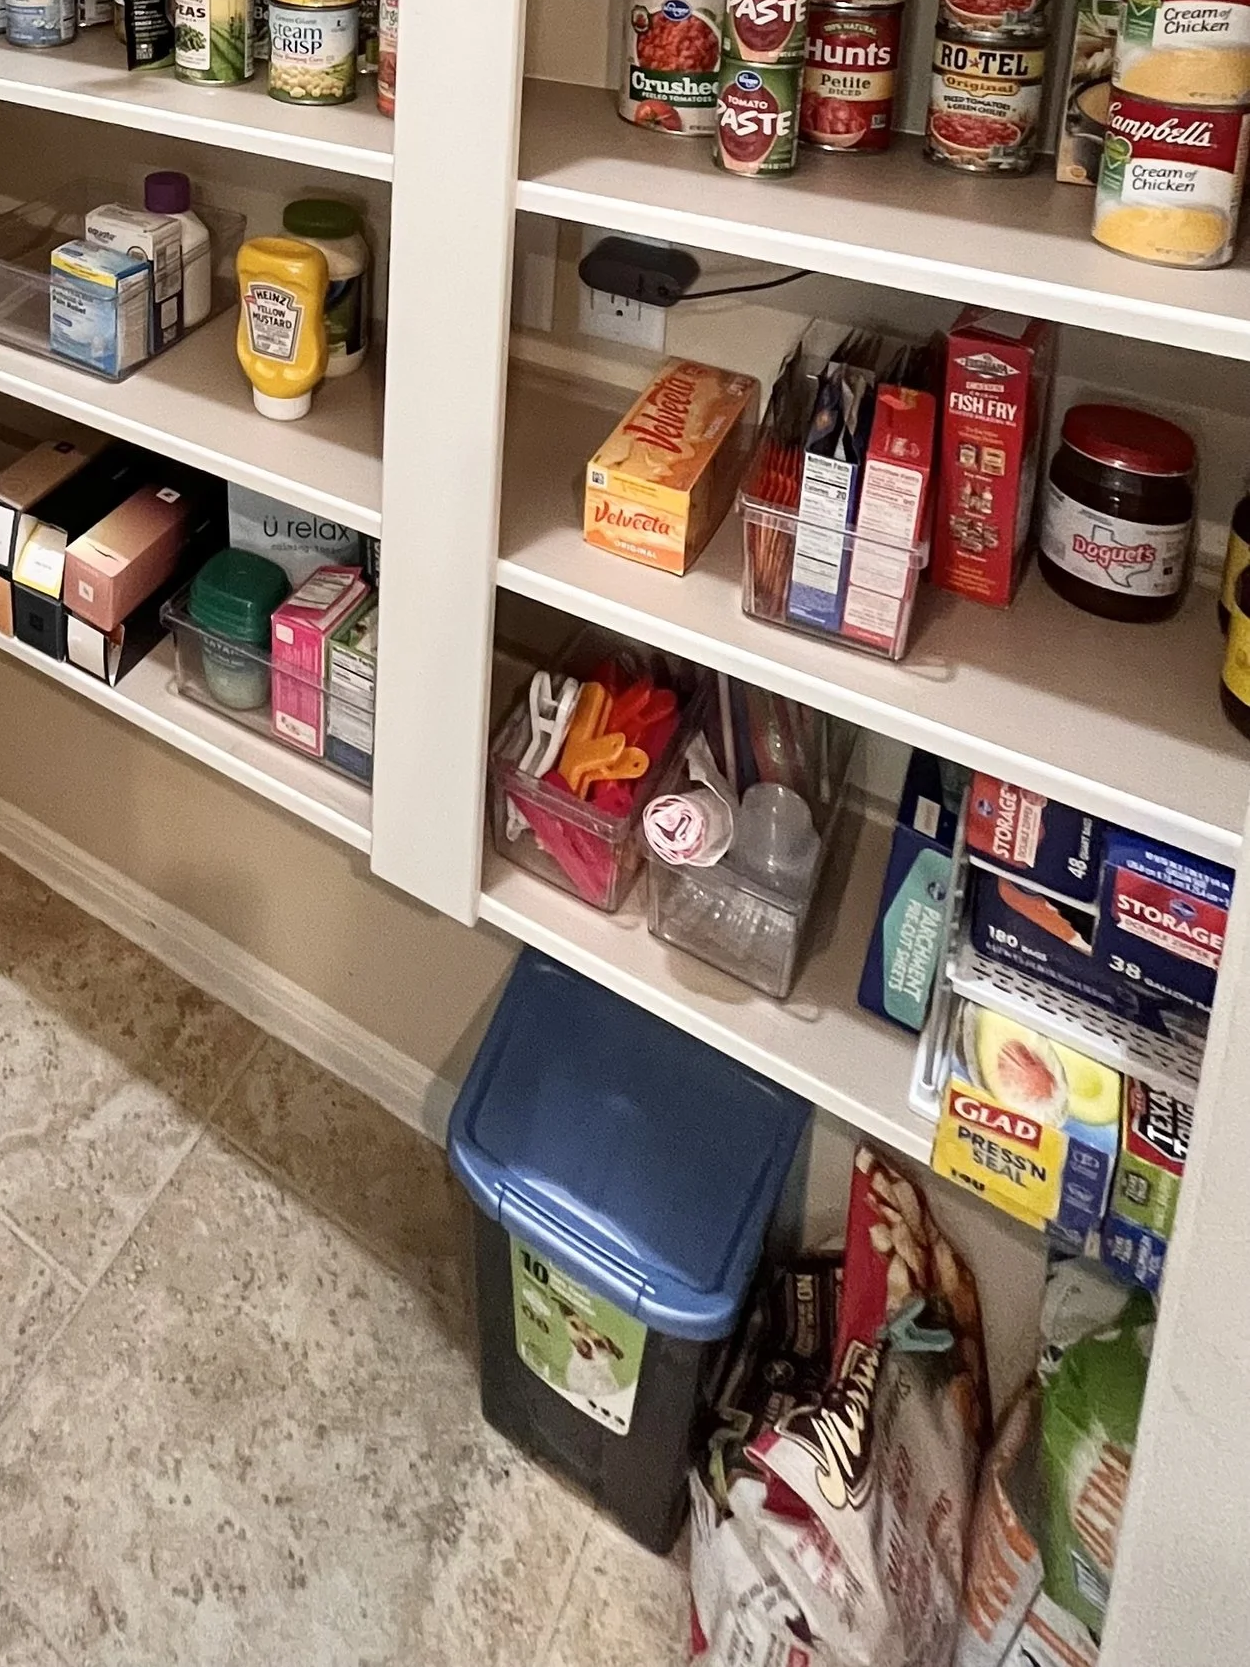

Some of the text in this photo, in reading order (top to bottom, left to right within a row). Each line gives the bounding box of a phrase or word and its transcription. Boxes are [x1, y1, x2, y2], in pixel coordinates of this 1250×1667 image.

[1163, 6, 1232, 22] Cream of
[272, 23, 323, 41] steam
[843, 23, 878, 35] NATURAL
[1163, 19, 1230, 35] Chicken
[272, 36, 323, 55] CRISP
[820, 73, 872, 90] Petite
[828, 87, 862, 97] DICED
[945, 76, 1019, 94] Original
[641, 91, 714, 103] PEELED TOMATOES
[727, 94, 768, 109] TOMATO
[717, 98, 792, 137] PASTE
[1131, 164, 1198, 182] Cream of
[1131, 177, 1196, 193] Chicken
[255, 290, 287, 306] HEINZ
[252, 312, 293, 330] MUSTARD
[257, 304, 286, 318] YELLOW
[623, 375, 697, 455] Velveeta
[949, 391, 984, 415] FISH
[987, 399, 1018, 422] FRY
[836, 489, 847, 501] 20
[594, 500, 671, 536] Velveeta
[287, 517, 351, 543] relax
[614, 539, 658, 560] ORIGINAL
[992, 782, 1018, 859] STORAGE
[1067, 856, 1088, 880] 48
[1117, 893, 1224, 951] STORAGE
[888, 898, 922, 993] PRE-CUT SHEETS
[987, 924, 1019, 949] 180
[904, 903, 942, 1004] PARCHMENT
[1108, 953, 1142, 981] 38
[952, 1098, 1039, 1142] GLAD
[957, 1124, 1048, 1183] PRESS'N
[972, 1149, 1027, 1189] SEAL
[520, 1249, 549, 1289] 10
